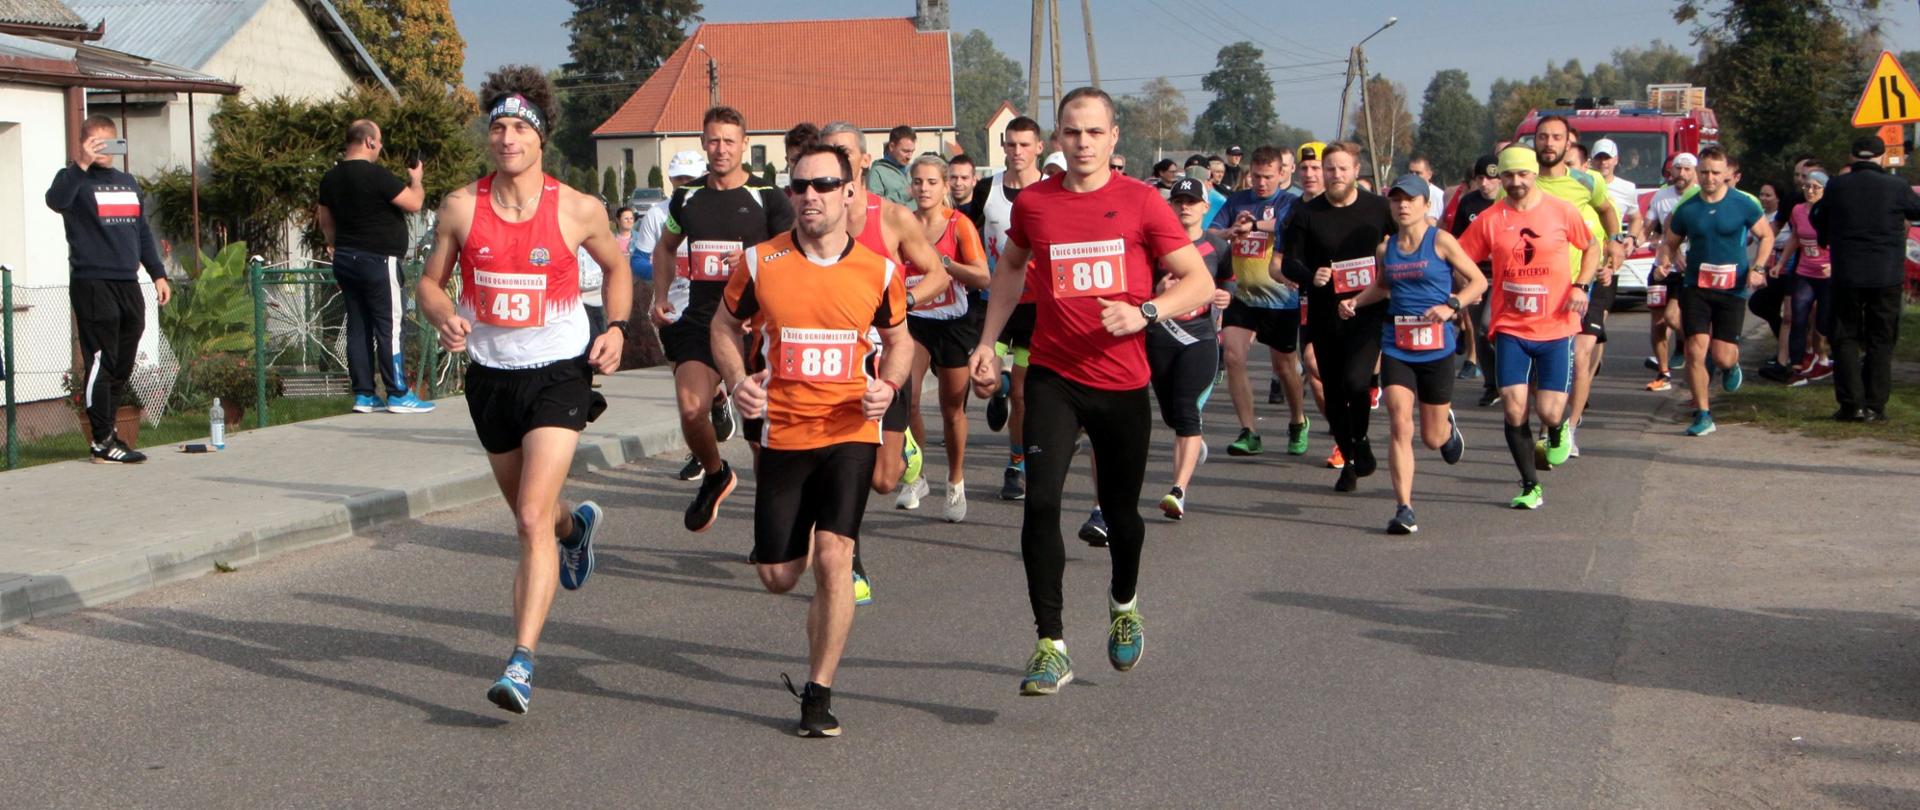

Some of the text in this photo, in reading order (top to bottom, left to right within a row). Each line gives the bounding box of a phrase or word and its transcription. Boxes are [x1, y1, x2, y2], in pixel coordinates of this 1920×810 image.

[518, 106, 540, 128] 2022
[1180, 180, 1192, 190] NY
[1055, 248, 1071, 257] BIEG
[1072, 243, 1122, 255] OGNIOMISTRZA
[1240, 240, 1260, 255] 32
[704, 255, 729, 277] 61
[1518, 267, 1549, 276] RYCERSKI
[1072, 261, 1113, 291] 80
[1346, 269, 1371, 288] 58
[1711, 273, 1727, 287] 77
[492, 293, 530, 321] 43
[1515, 296, 1538, 313] 44
[787, 332, 803, 340] BIEG
[1409, 327, 1433, 346] 18
[801, 348, 842, 377] 88
